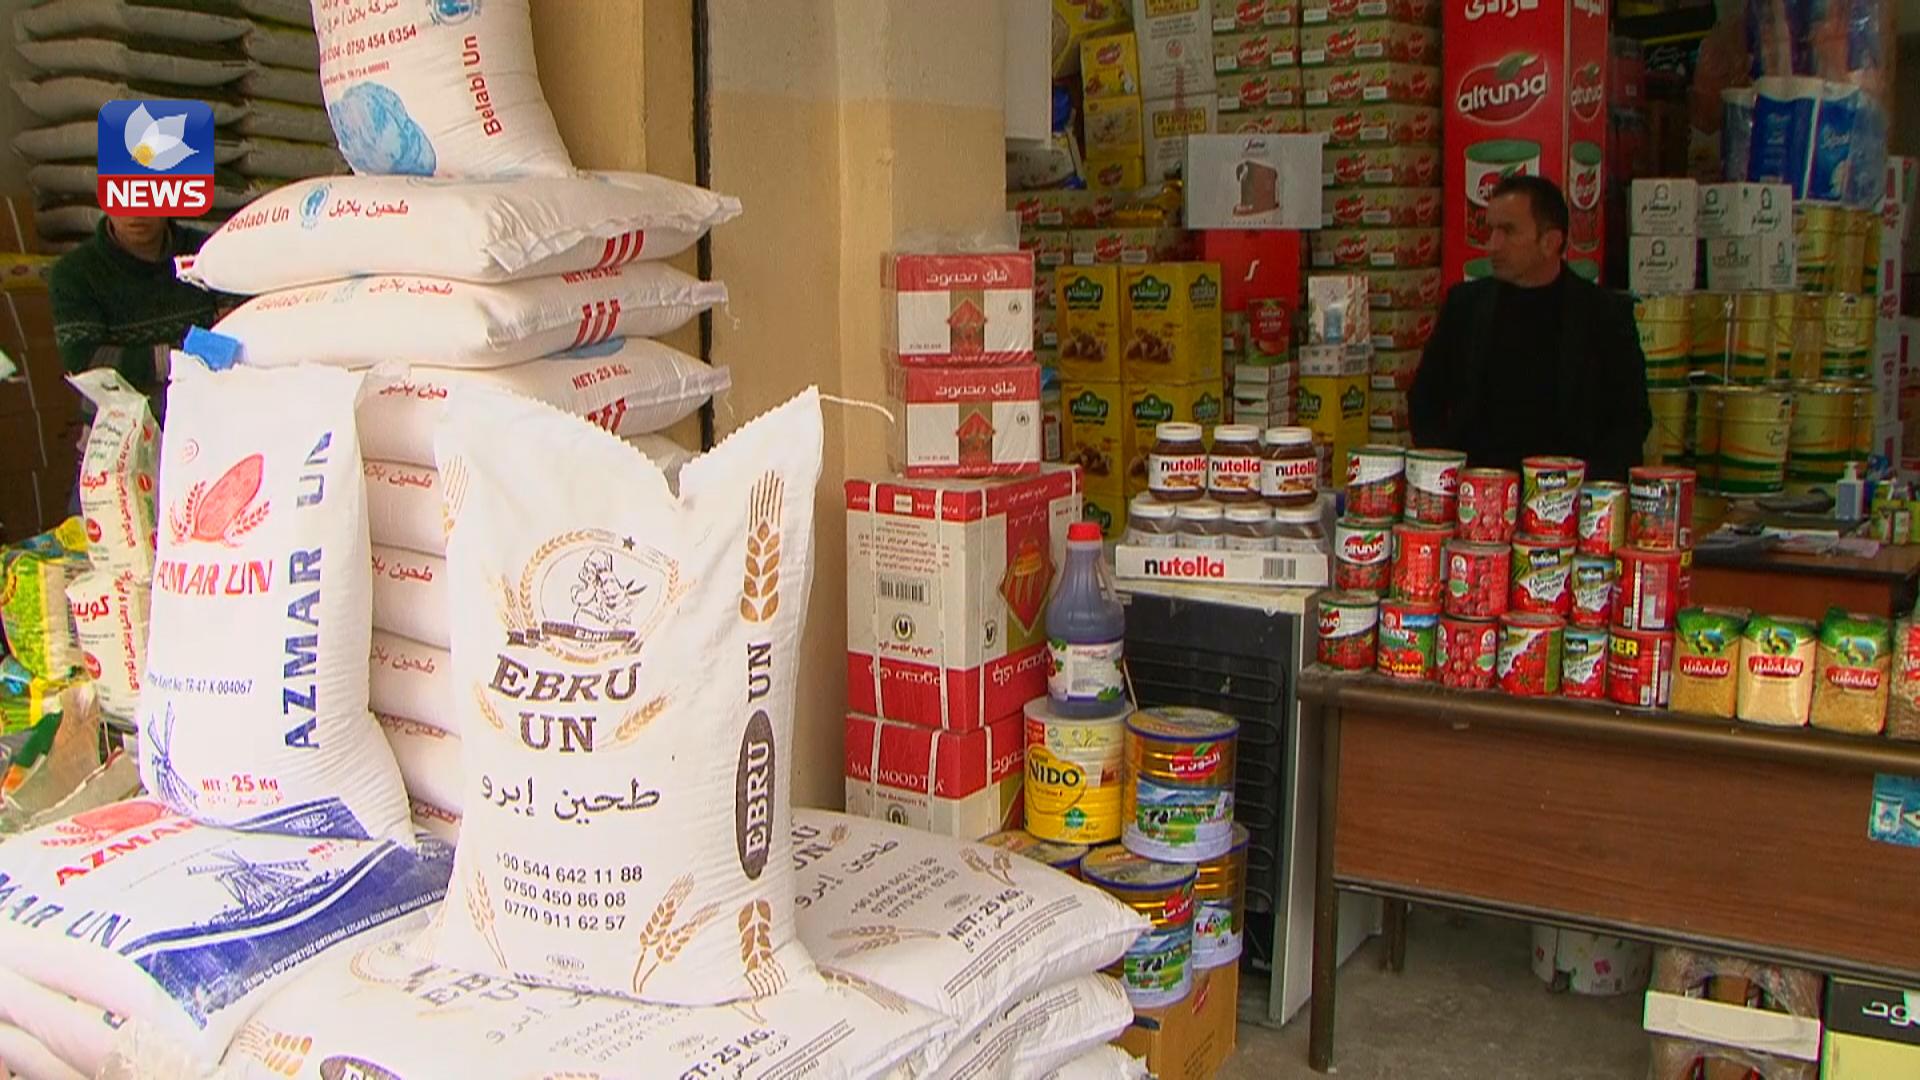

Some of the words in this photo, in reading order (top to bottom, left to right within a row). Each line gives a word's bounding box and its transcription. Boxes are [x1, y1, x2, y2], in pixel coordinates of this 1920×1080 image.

[367, 33, 386, 49] 454
[463, 35, 481, 67] Un
[466, 73, 502, 137] Belabl
[1457, 72, 1548, 114] altunsa
[271, 206, 290, 224] Un
[365, 199, 409, 217] طحين
[926, 272, 978, 286] محمود
[935, 385, 986, 398] محمود
[296, 431, 333, 508] UN
[389, 471, 433, 488] طحين
[1212, 458, 1261, 473] nutella
[224, 560, 273, 595] UN
[389, 562, 433, 583] طحين
[1144, 556, 1225, 578] nutella
[283, 547, 322, 749] AZMAR
[391, 653, 436, 675] طحين
[488, 653, 642, 703] EBRU
[747, 642, 772, 704] UN
[518, 711, 597, 753] UN
[231, 774, 255, 792] 25
[851, 761, 918, 786] MAMOOD
[1029, 757, 1081, 787] NIDO
[480, 774, 536, 818] إبرو
[554, 777, 661, 825] طحين
[746, 741, 771, 858] EBRU
[523, 860, 550, 881] 544
[555, 866, 587, 884] 642
[593, 868, 612, 884] 11
[620, 865, 643, 882] 88
[503, 876, 537, 899] 0750
[542, 889, 572, 907] 450
[577, 891, 599, 908] 86
[604, 891, 627, 908] 08
[66, 910, 131, 949] UN
[504, 899, 538, 922] 0770
[543, 911, 571, 929] 911
[578, 913, 599, 931] 62
[605, 915, 627, 931] 57
[947, 913, 983, 942] NET:
[978, 899, 1001, 917] 25
[712, 1043, 740, 1066] 25
